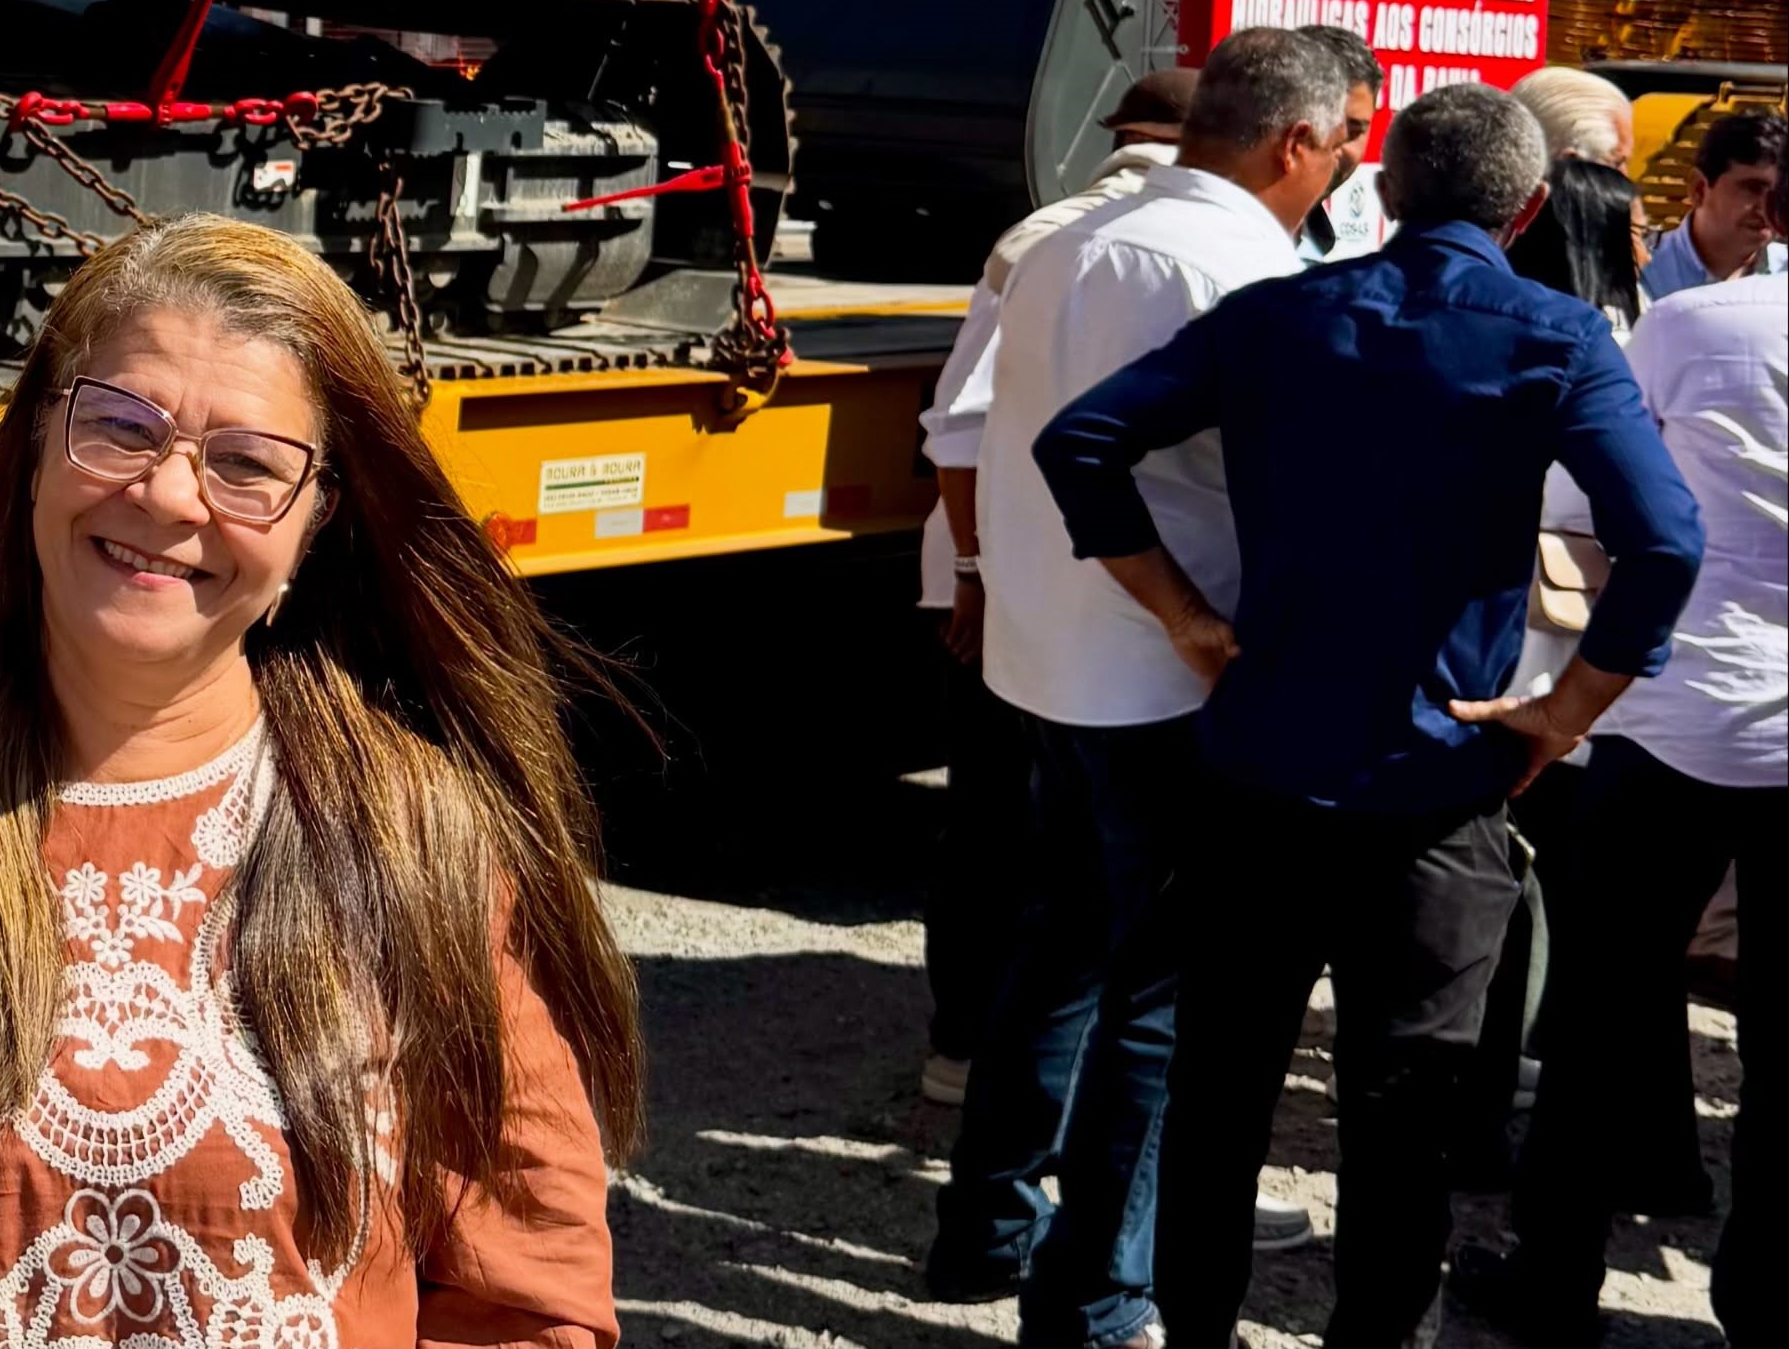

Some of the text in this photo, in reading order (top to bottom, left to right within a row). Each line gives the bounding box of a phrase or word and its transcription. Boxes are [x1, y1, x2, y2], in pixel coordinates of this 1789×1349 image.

[1373, 2, 1416, 51] AOS
[1418, 0, 1539, 60] CONSÓRCIOS
[1389, 63, 1418, 111] DA
